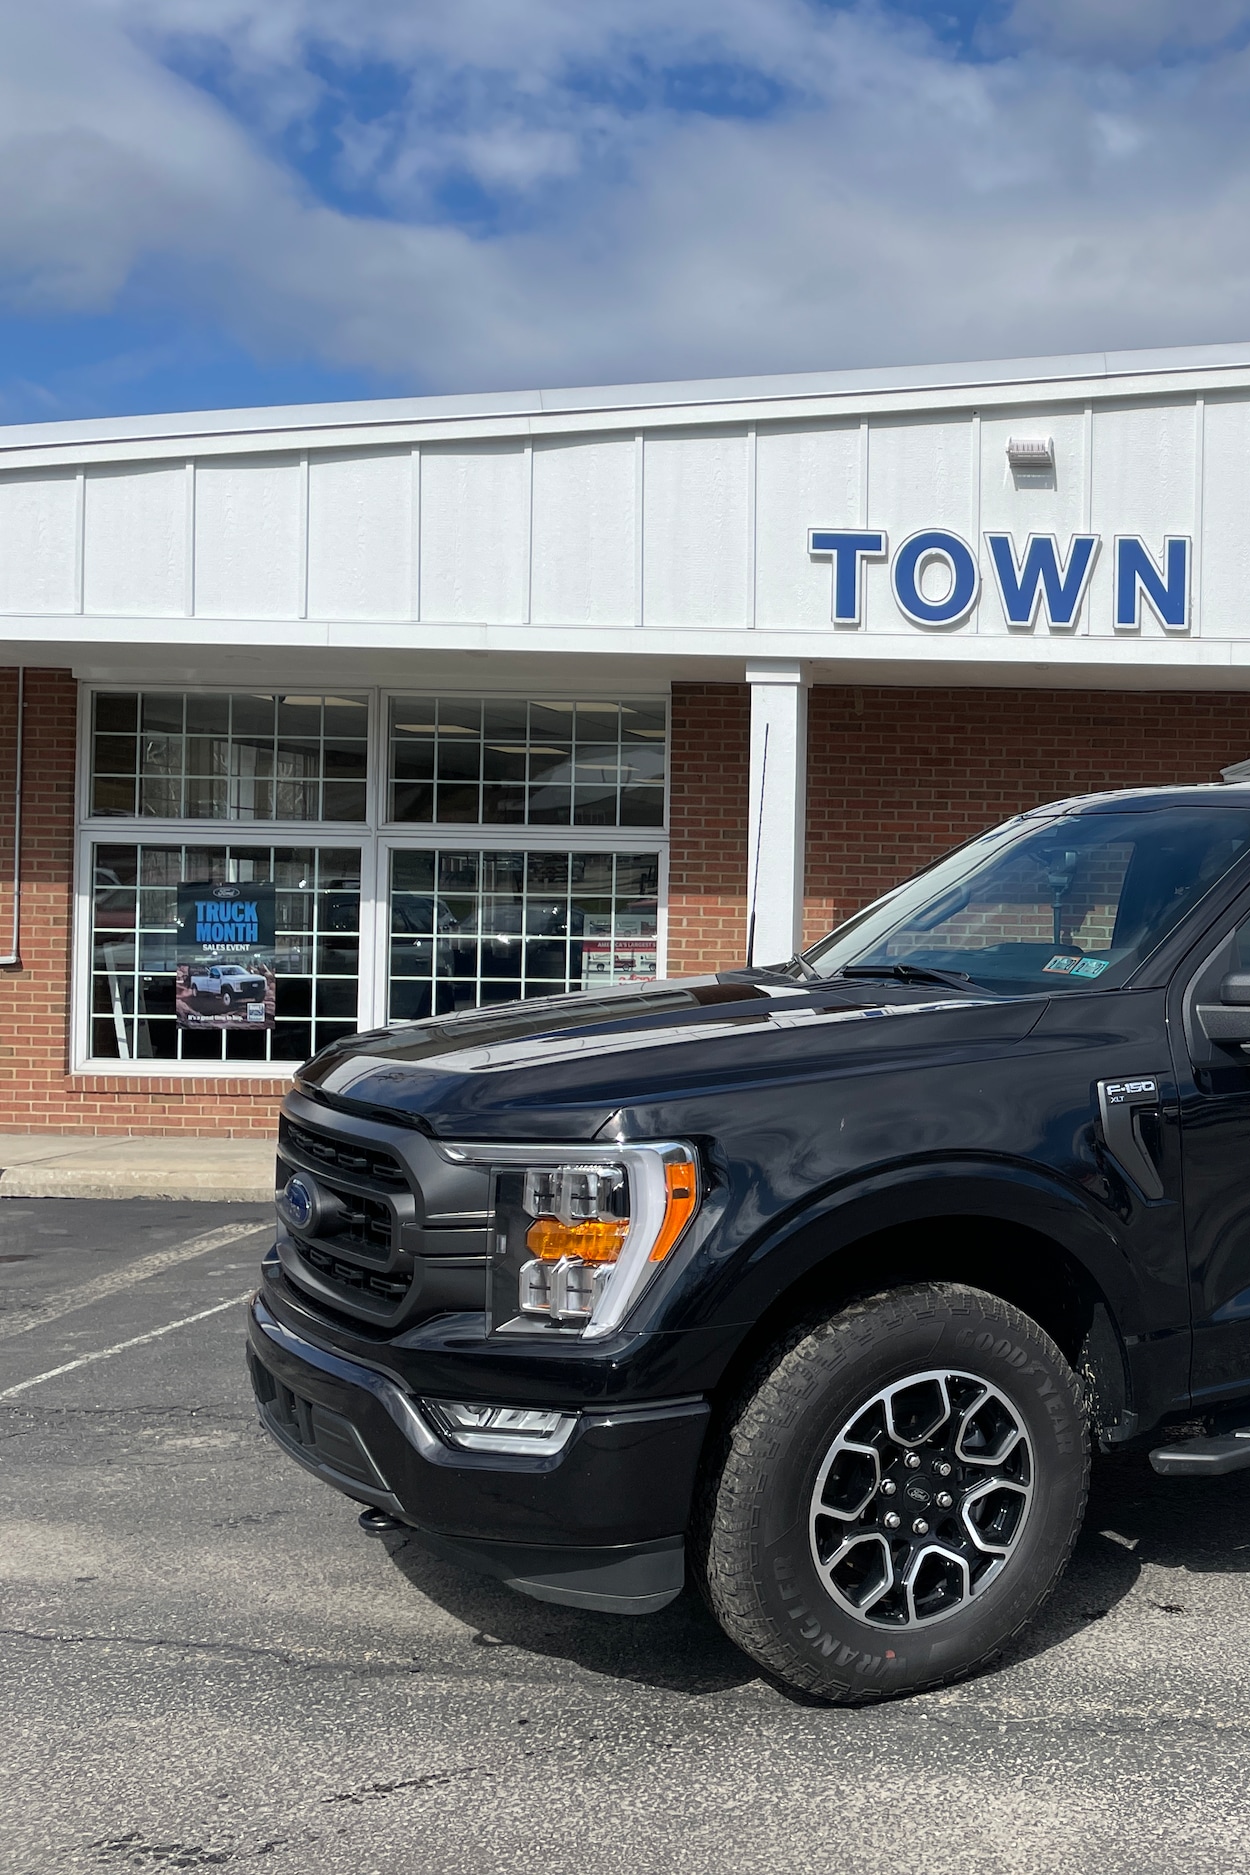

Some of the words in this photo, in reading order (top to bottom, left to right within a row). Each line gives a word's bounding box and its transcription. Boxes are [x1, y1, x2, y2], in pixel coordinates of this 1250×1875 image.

[808, 528, 1191, 630] TOWN
[195, 901, 258, 922] TRUCK
[196, 923, 258, 942] MONTH
[1106, 1081, 1156, 1095] F-150
